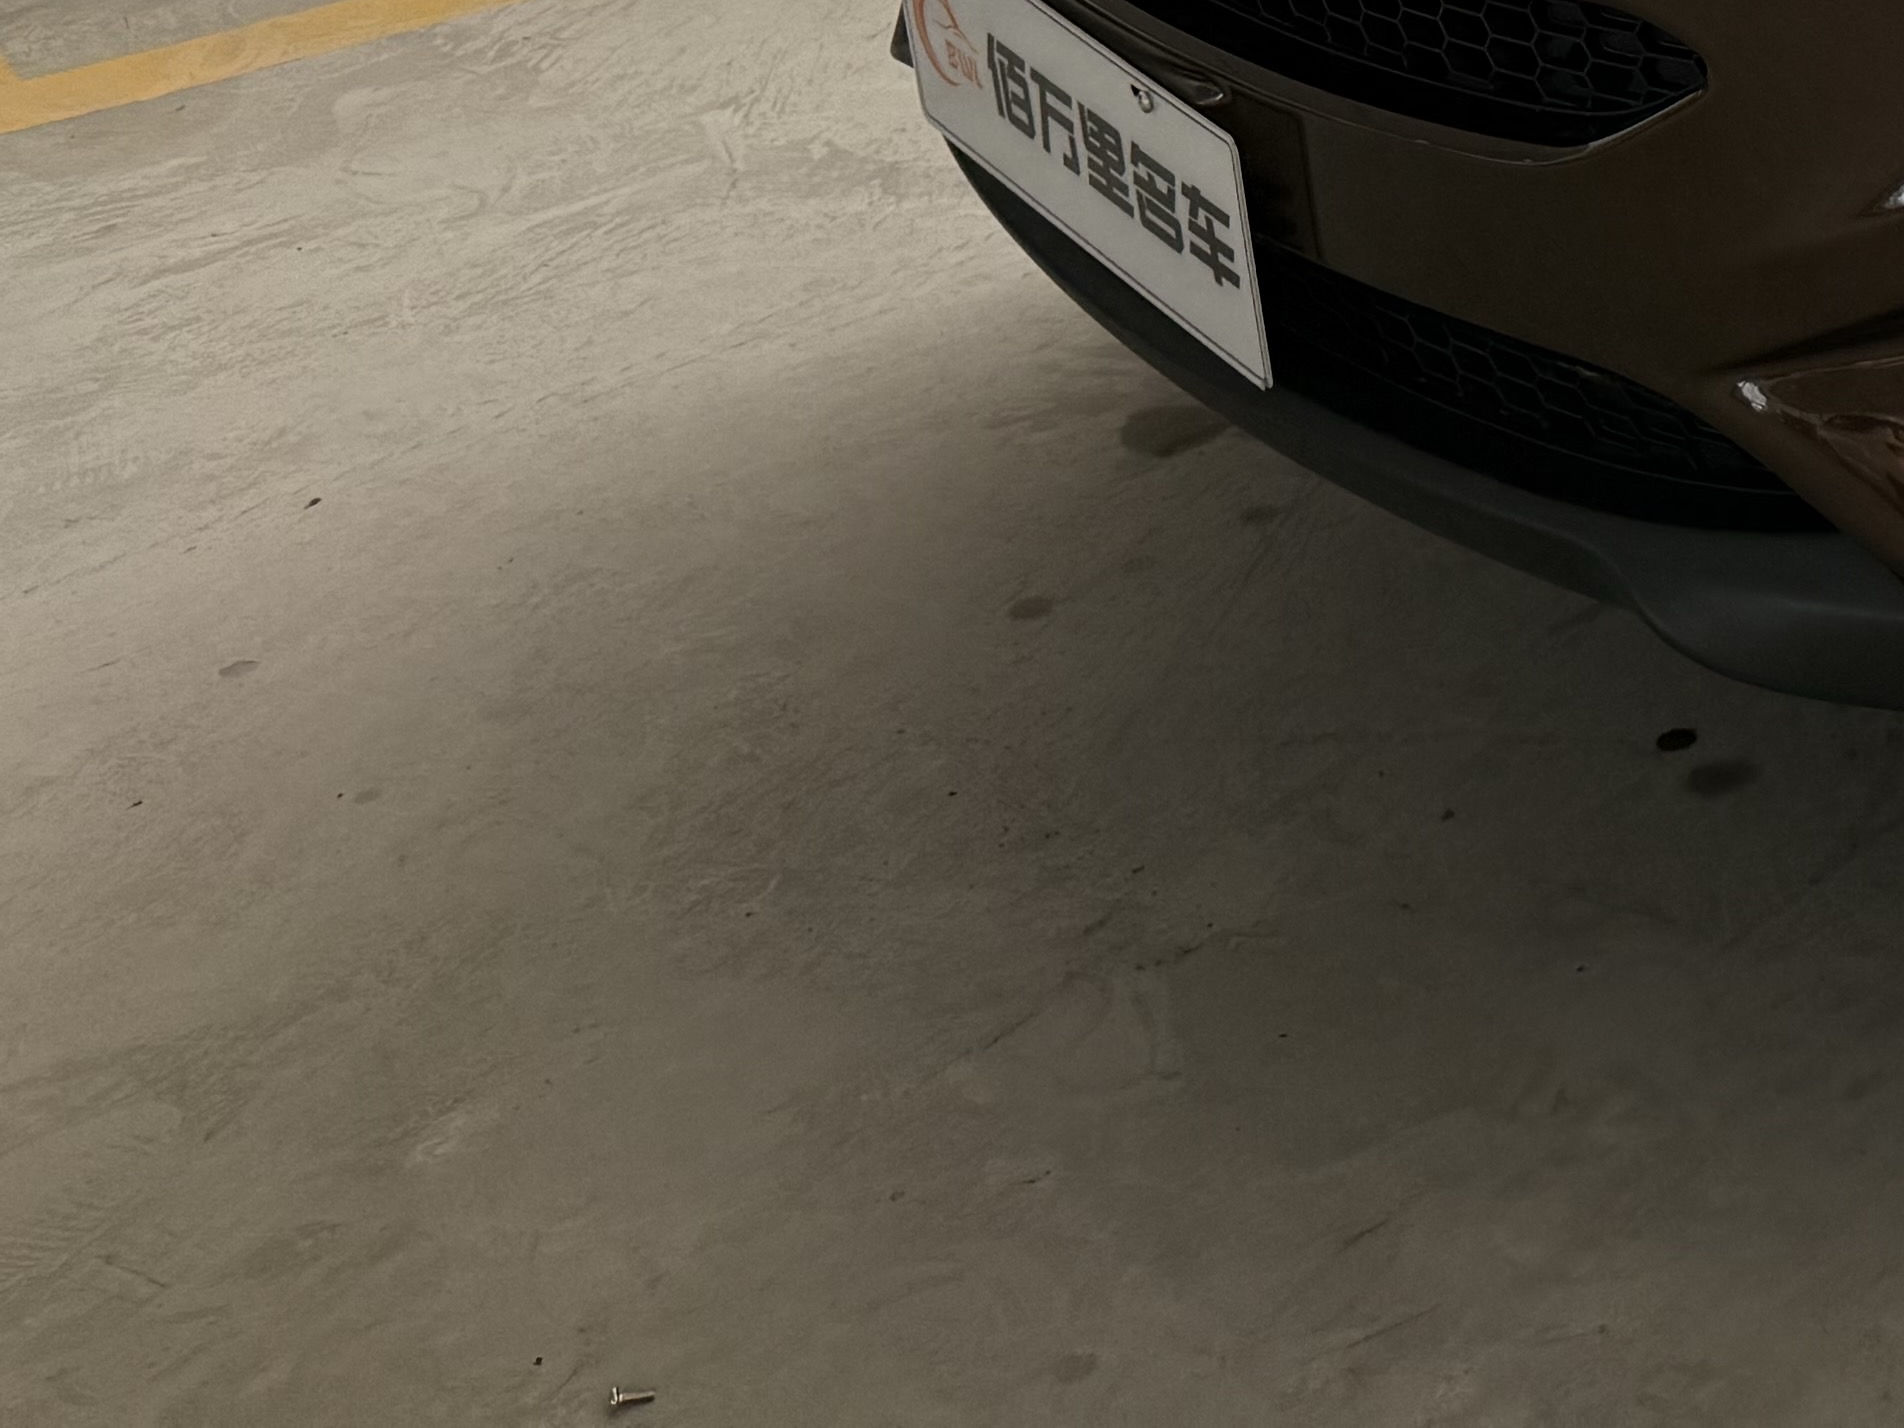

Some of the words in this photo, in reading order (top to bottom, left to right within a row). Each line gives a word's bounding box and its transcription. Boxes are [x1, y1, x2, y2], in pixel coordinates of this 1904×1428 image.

[986, 31, 1242, 290] 佰万里名车
